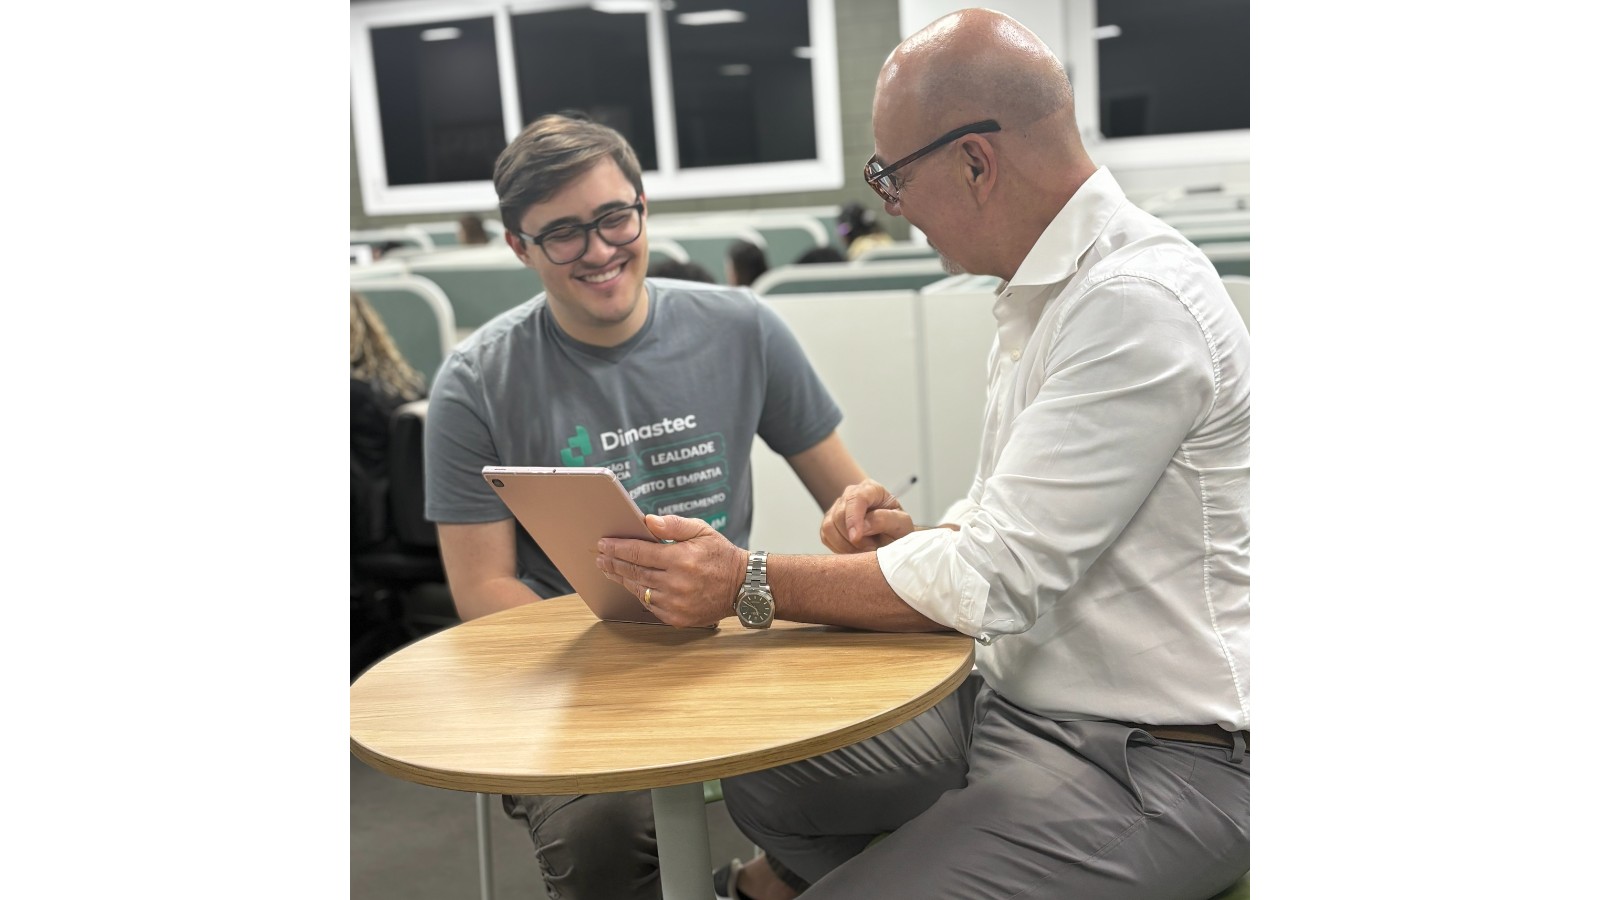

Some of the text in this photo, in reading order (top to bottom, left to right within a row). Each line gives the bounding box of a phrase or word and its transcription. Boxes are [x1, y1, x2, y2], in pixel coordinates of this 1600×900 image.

[601, 415, 697, 451] Dimastec
[651, 441, 716, 466] LEALDADE
[624, 461, 631, 470] E
[666, 478, 675, 489] E
[676, 466, 722, 487] EMPATIA
[658, 493, 726, 516] MERECIMENTO
